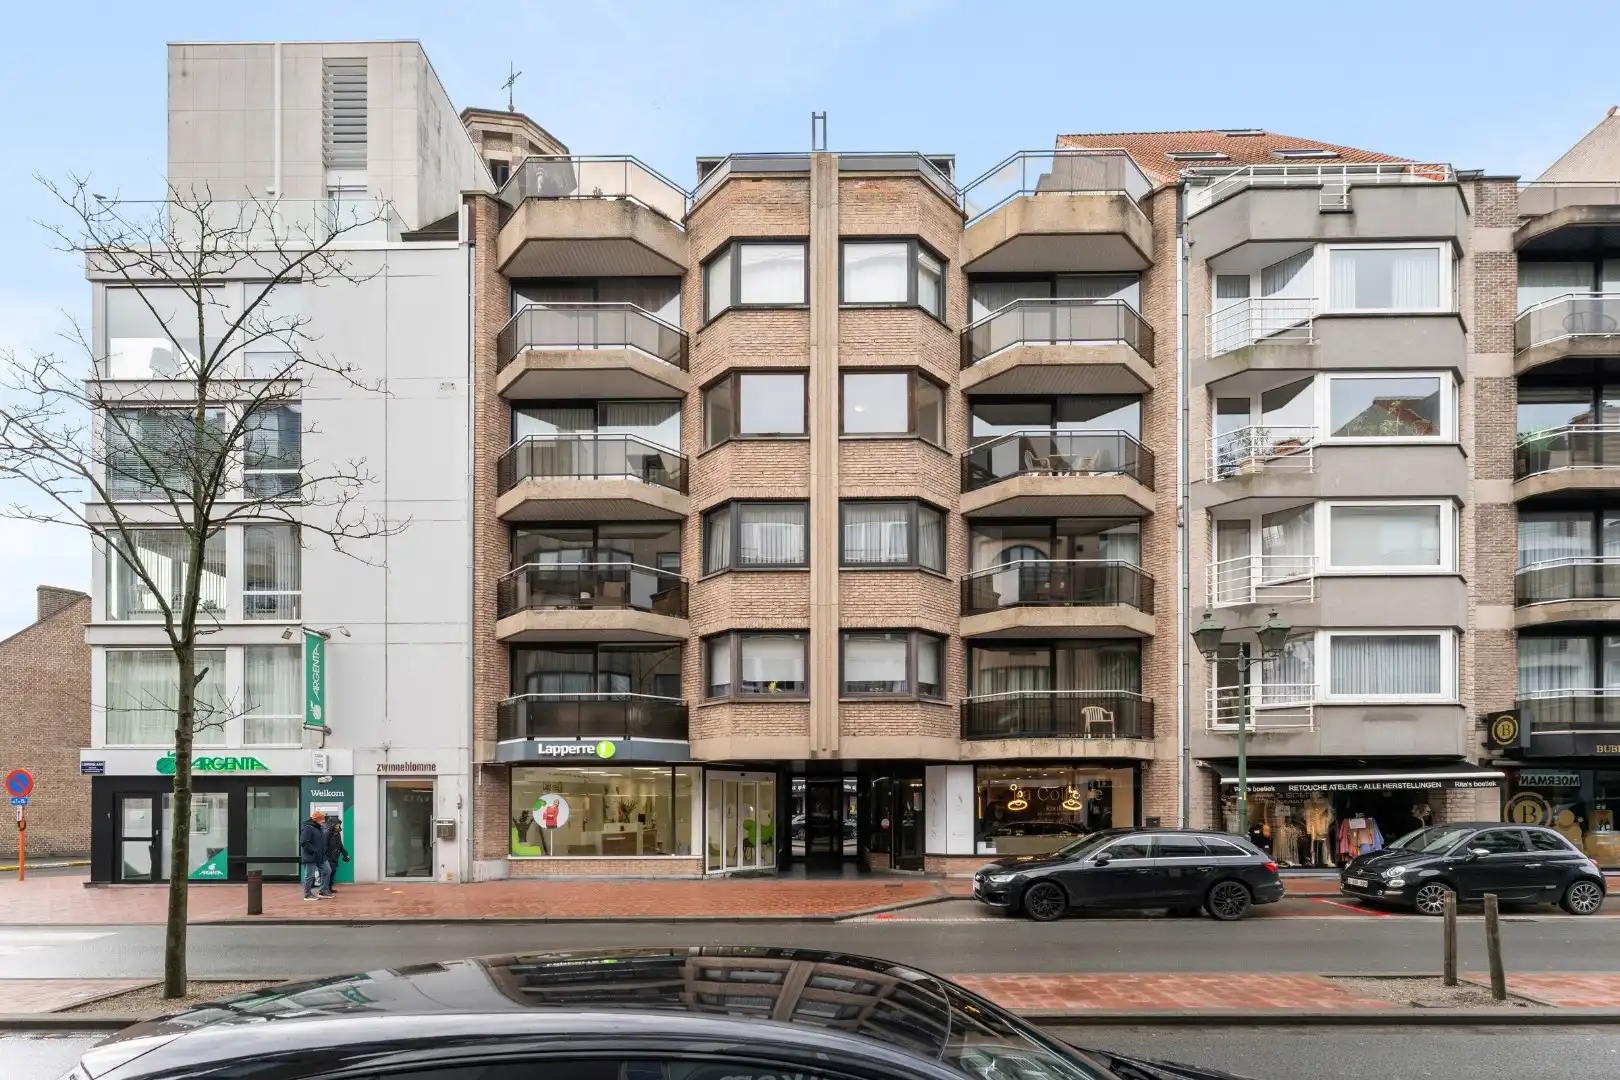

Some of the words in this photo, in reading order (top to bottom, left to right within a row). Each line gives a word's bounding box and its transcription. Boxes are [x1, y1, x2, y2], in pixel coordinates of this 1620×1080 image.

[312, 642, 320, 701] ARGENTA
[1501, 724, 1511, 736] B
[538, 743, 596, 757] Lapperre
[1596, 745, 1620, 753] BUB
[191, 756, 272, 771] ARGENTA
[376, 761, 437, 772] zwinneblomme
[1329, 783, 1358, 791] ATELIER
[1473, 780, 1497, 788] boetiek
[310, 789, 345, 797] Welkom
[1522, 805, 1538, 823] B
